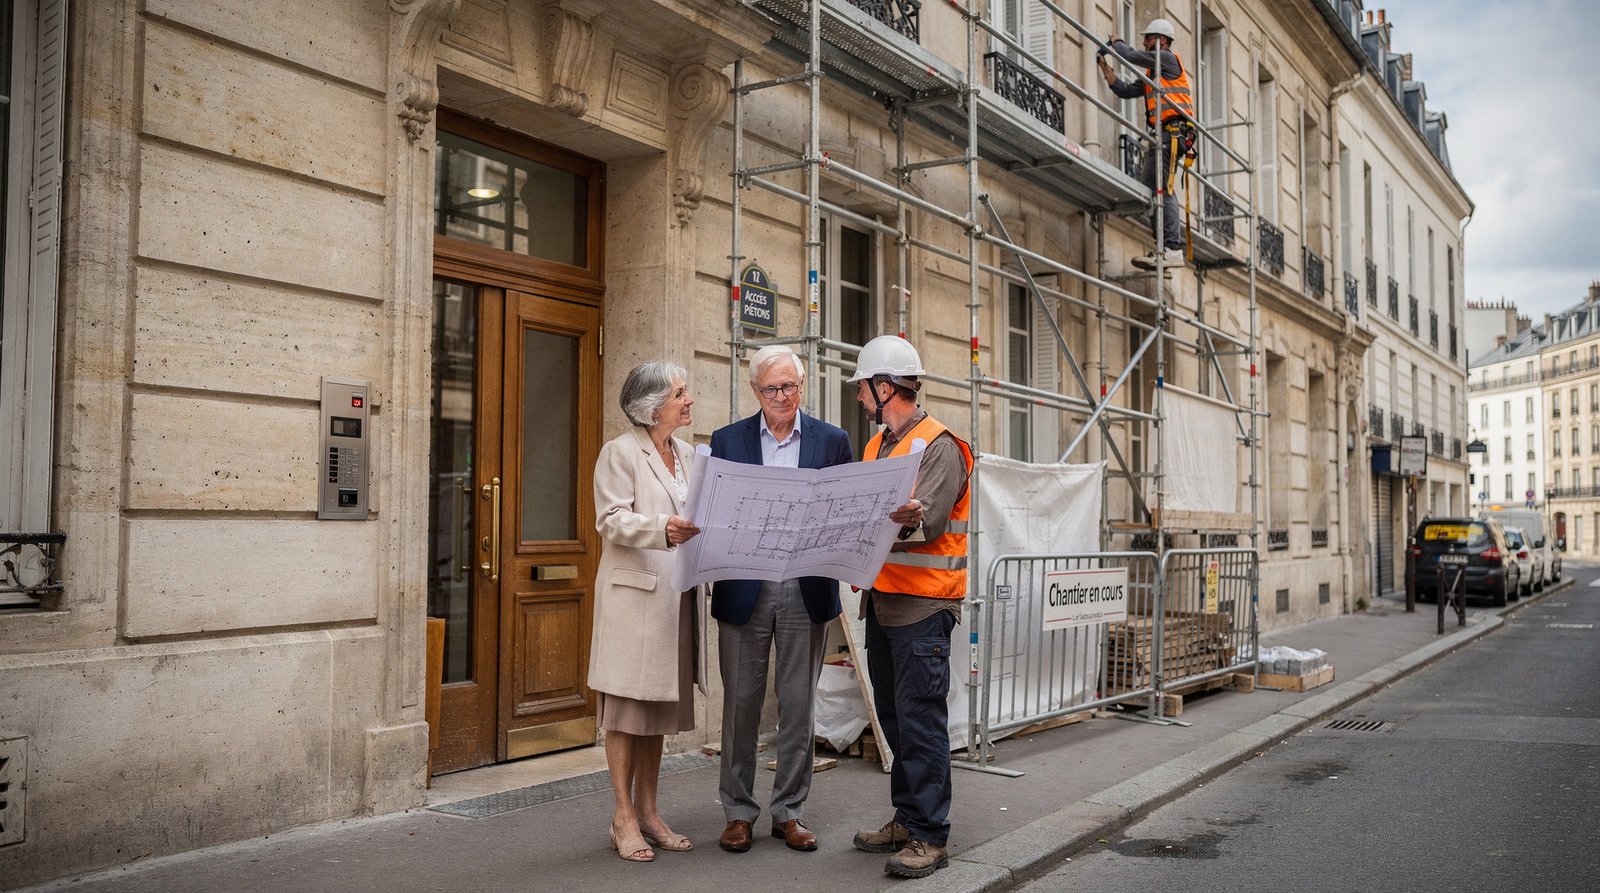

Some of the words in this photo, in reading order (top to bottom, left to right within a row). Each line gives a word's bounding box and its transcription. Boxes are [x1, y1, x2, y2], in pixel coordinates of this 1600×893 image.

[752, 270, 760, 283] 12
[1049, 582, 1088, 607] Chantier
[1089, 586, 1100, 603] en
[1101, 585, 1123, 602] cours
